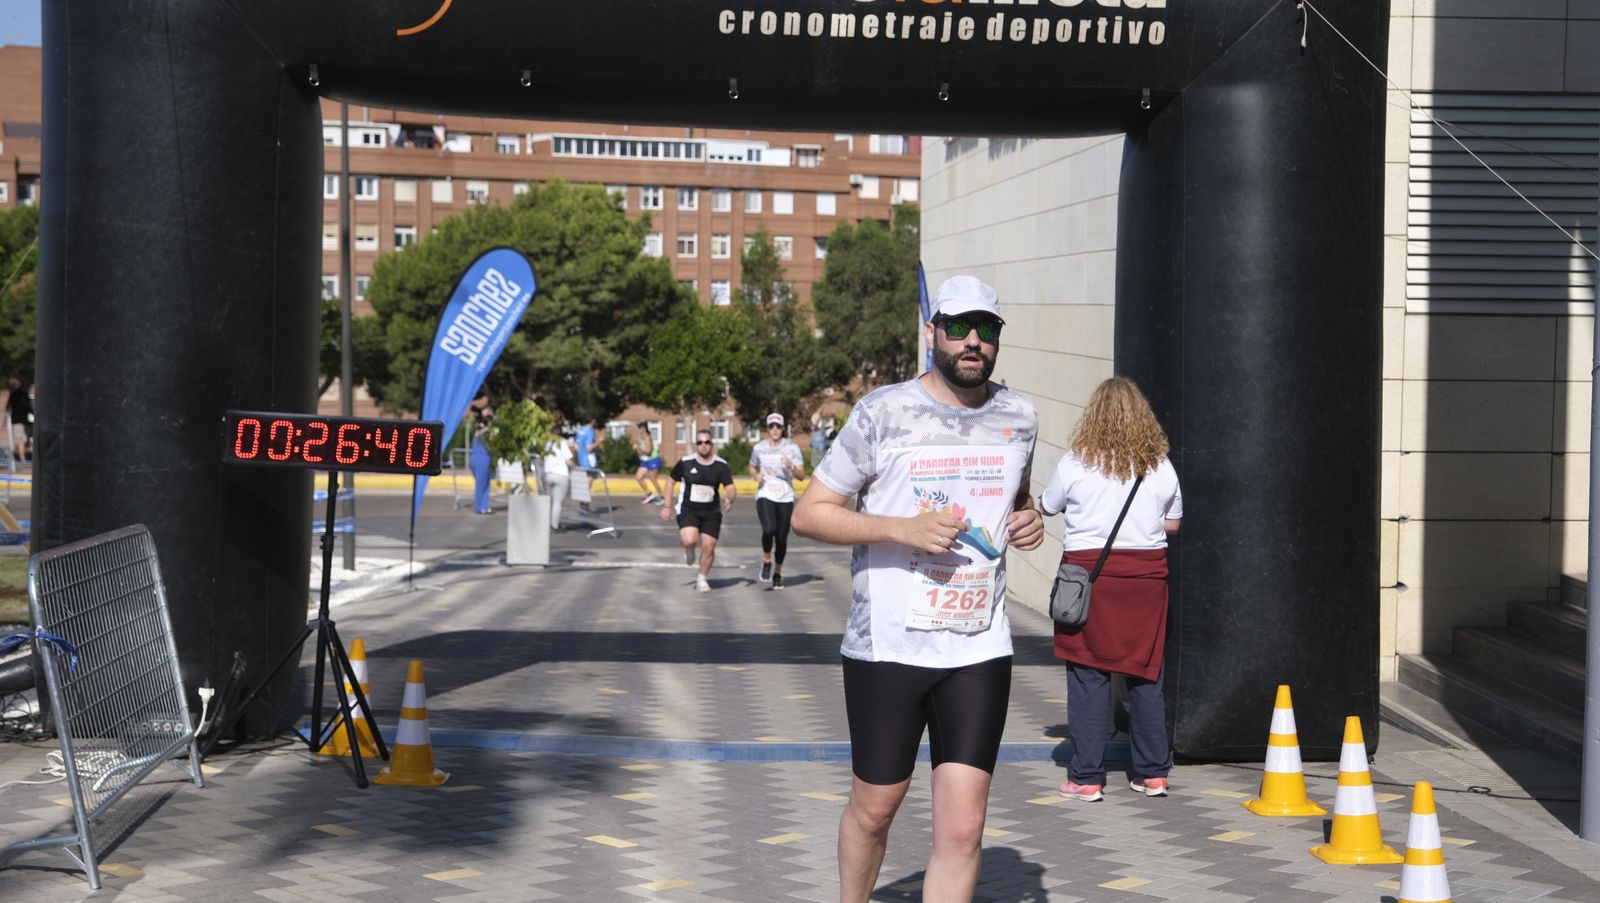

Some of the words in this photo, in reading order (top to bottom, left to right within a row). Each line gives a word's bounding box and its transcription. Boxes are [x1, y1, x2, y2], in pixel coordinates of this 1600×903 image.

[719, 8, 975, 42] cronometraje
[986, 13, 1166, 45] deportivo
[235, 418, 432, 468] 00:26:40
[920, 457, 960, 469] CARRERA
[962, 456, 978, 467] SIN
[981, 455, 1005, 467] HUMO
[970, 487, 976, 497] 4
[979, 487, 1004, 497] JUNIO
[926, 587, 989, 611] 1262
